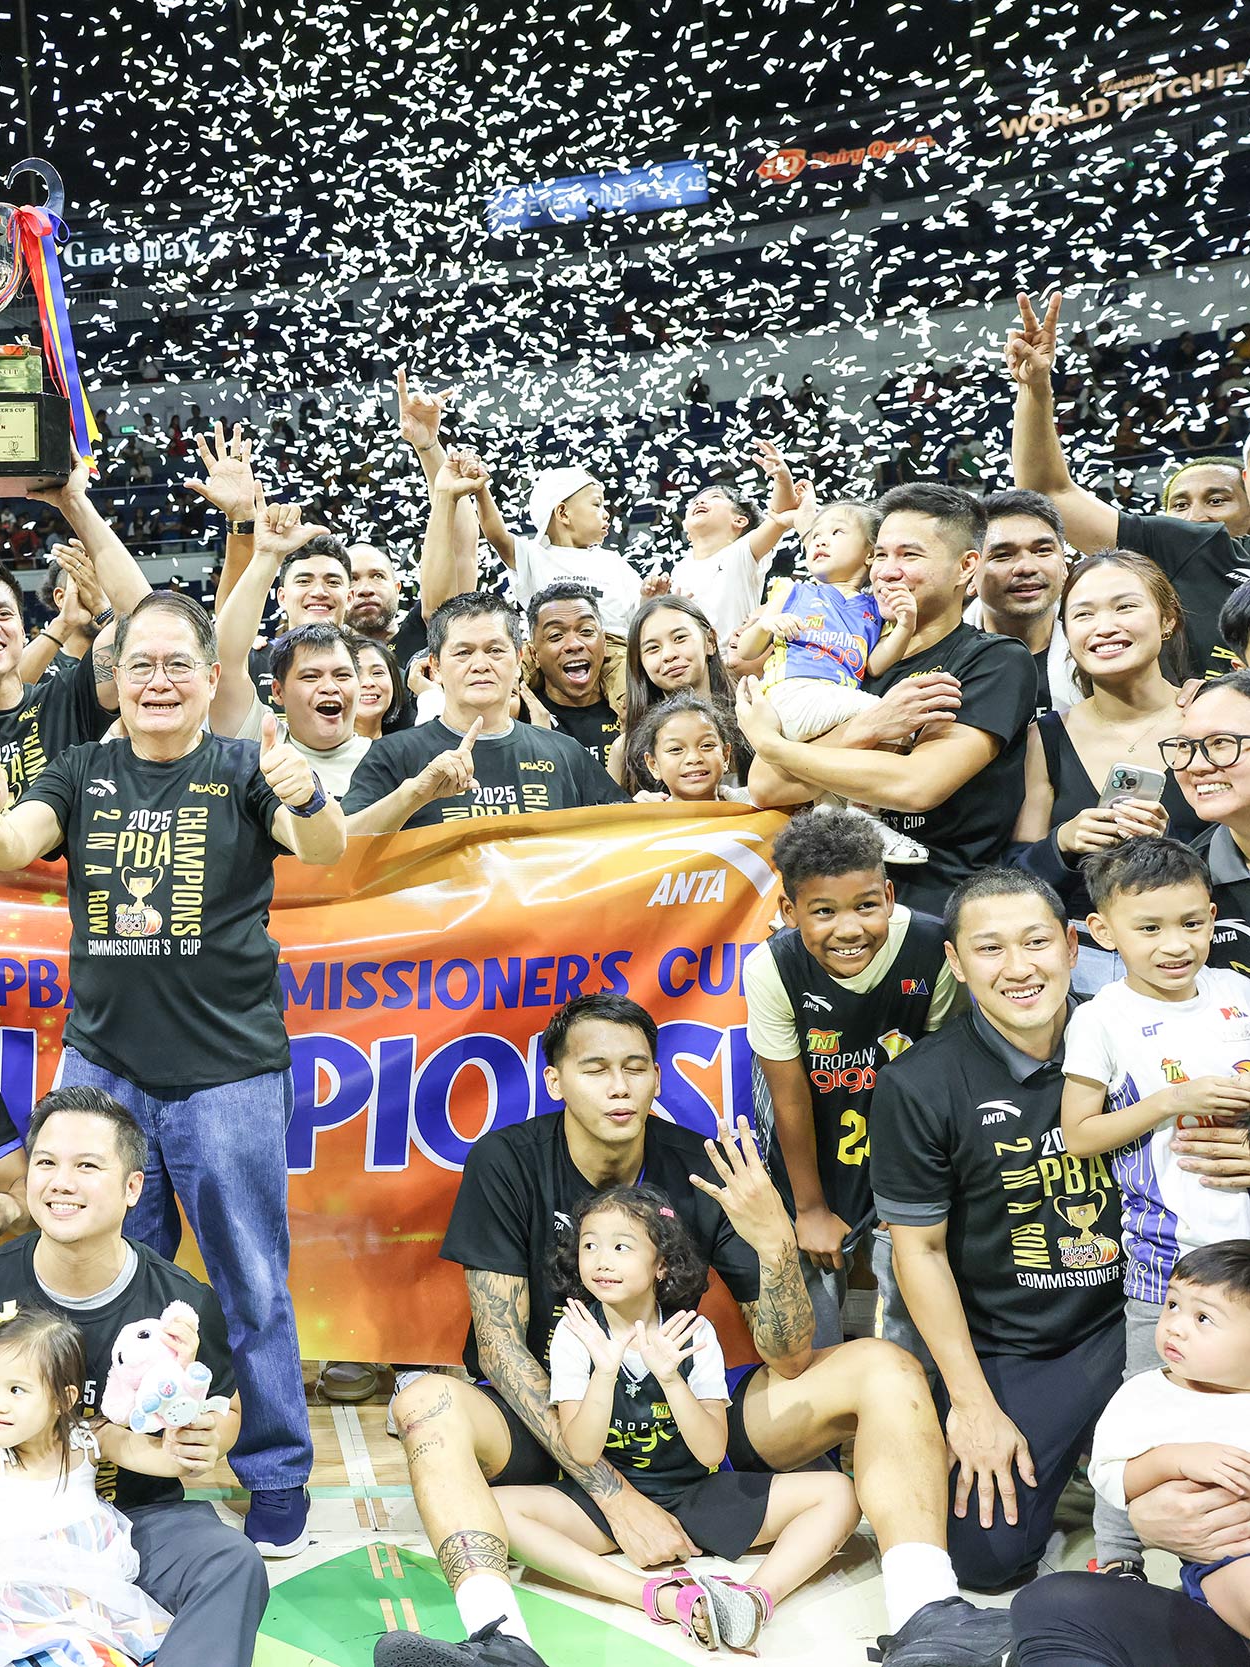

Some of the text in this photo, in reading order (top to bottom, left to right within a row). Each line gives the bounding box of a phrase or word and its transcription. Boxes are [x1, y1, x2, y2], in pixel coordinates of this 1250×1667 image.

[1000, 98, 1111, 140] WORLD
[471, 785, 517, 805] 2025
[126, 808, 173, 832] 2025
[903, 816, 926, 830] CUP
[116, 831, 171, 869] PBA
[84, 808, 122, 935] 2 IN A ROW
[170, 806, 209, 937] CHAMPIONS
[646, 869, 727, 907] ANTA
[88, 938, 202, 956] COMMISSIONER'S CUP
[1212, 930, 1238, 945] ANTA
[279, 949, 634, 1012] MISSIONER'S
[807, 1029, 841, 1051] TNT
[981, 1112, 1007, 1126] ANTA
[1037, 1153, 1113, 1197] PBA
[994, 1137, 1052, 1270] 2 IN A ROW
